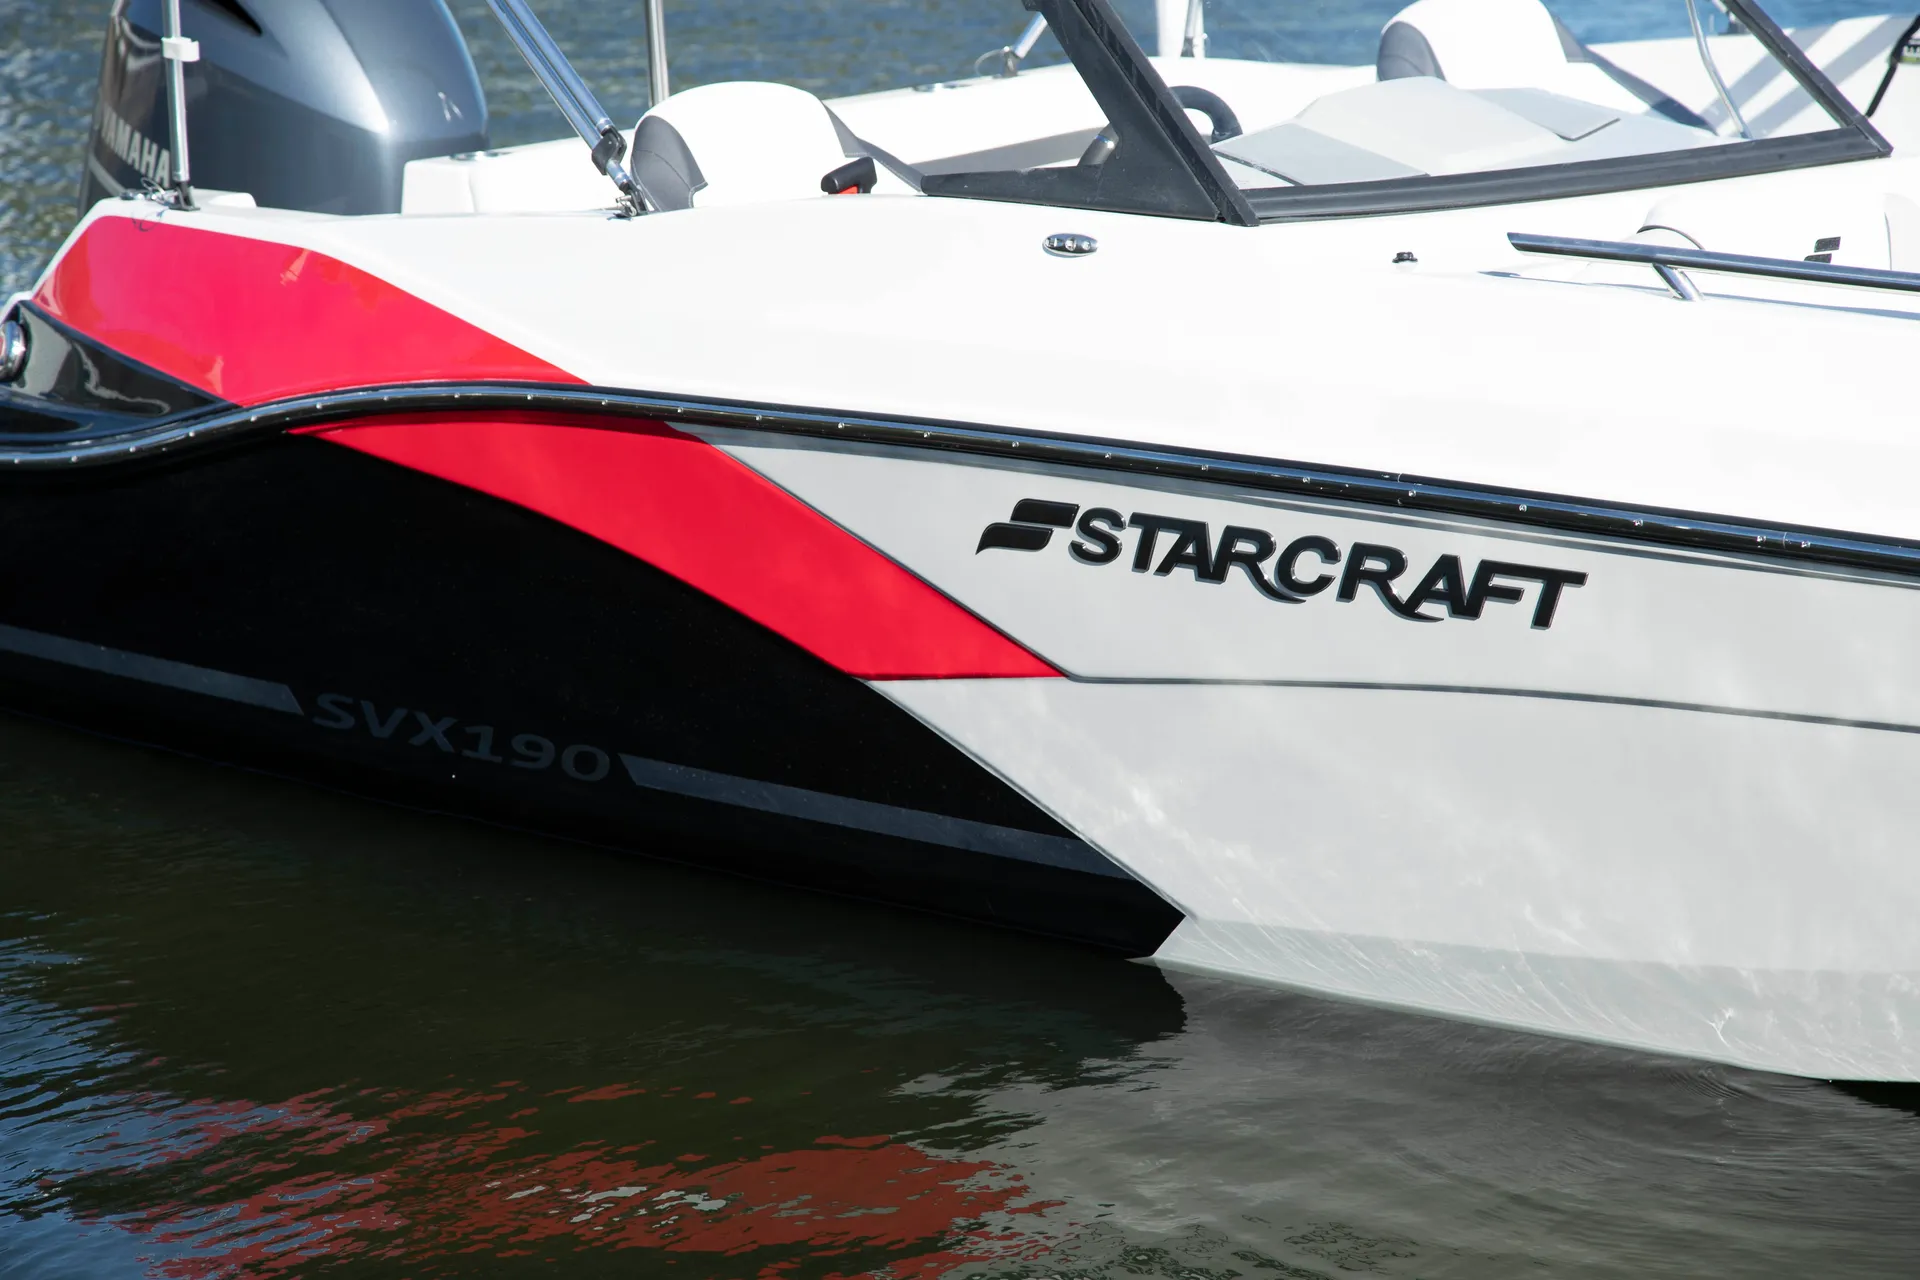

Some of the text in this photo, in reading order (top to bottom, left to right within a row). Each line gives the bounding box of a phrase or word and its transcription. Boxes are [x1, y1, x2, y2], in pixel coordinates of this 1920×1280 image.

[102, 103, 170, 189] YAMAHA
[1068, 507, 1589, 630] STARCRAFT
[312, 693, 610, 782] SVX190
